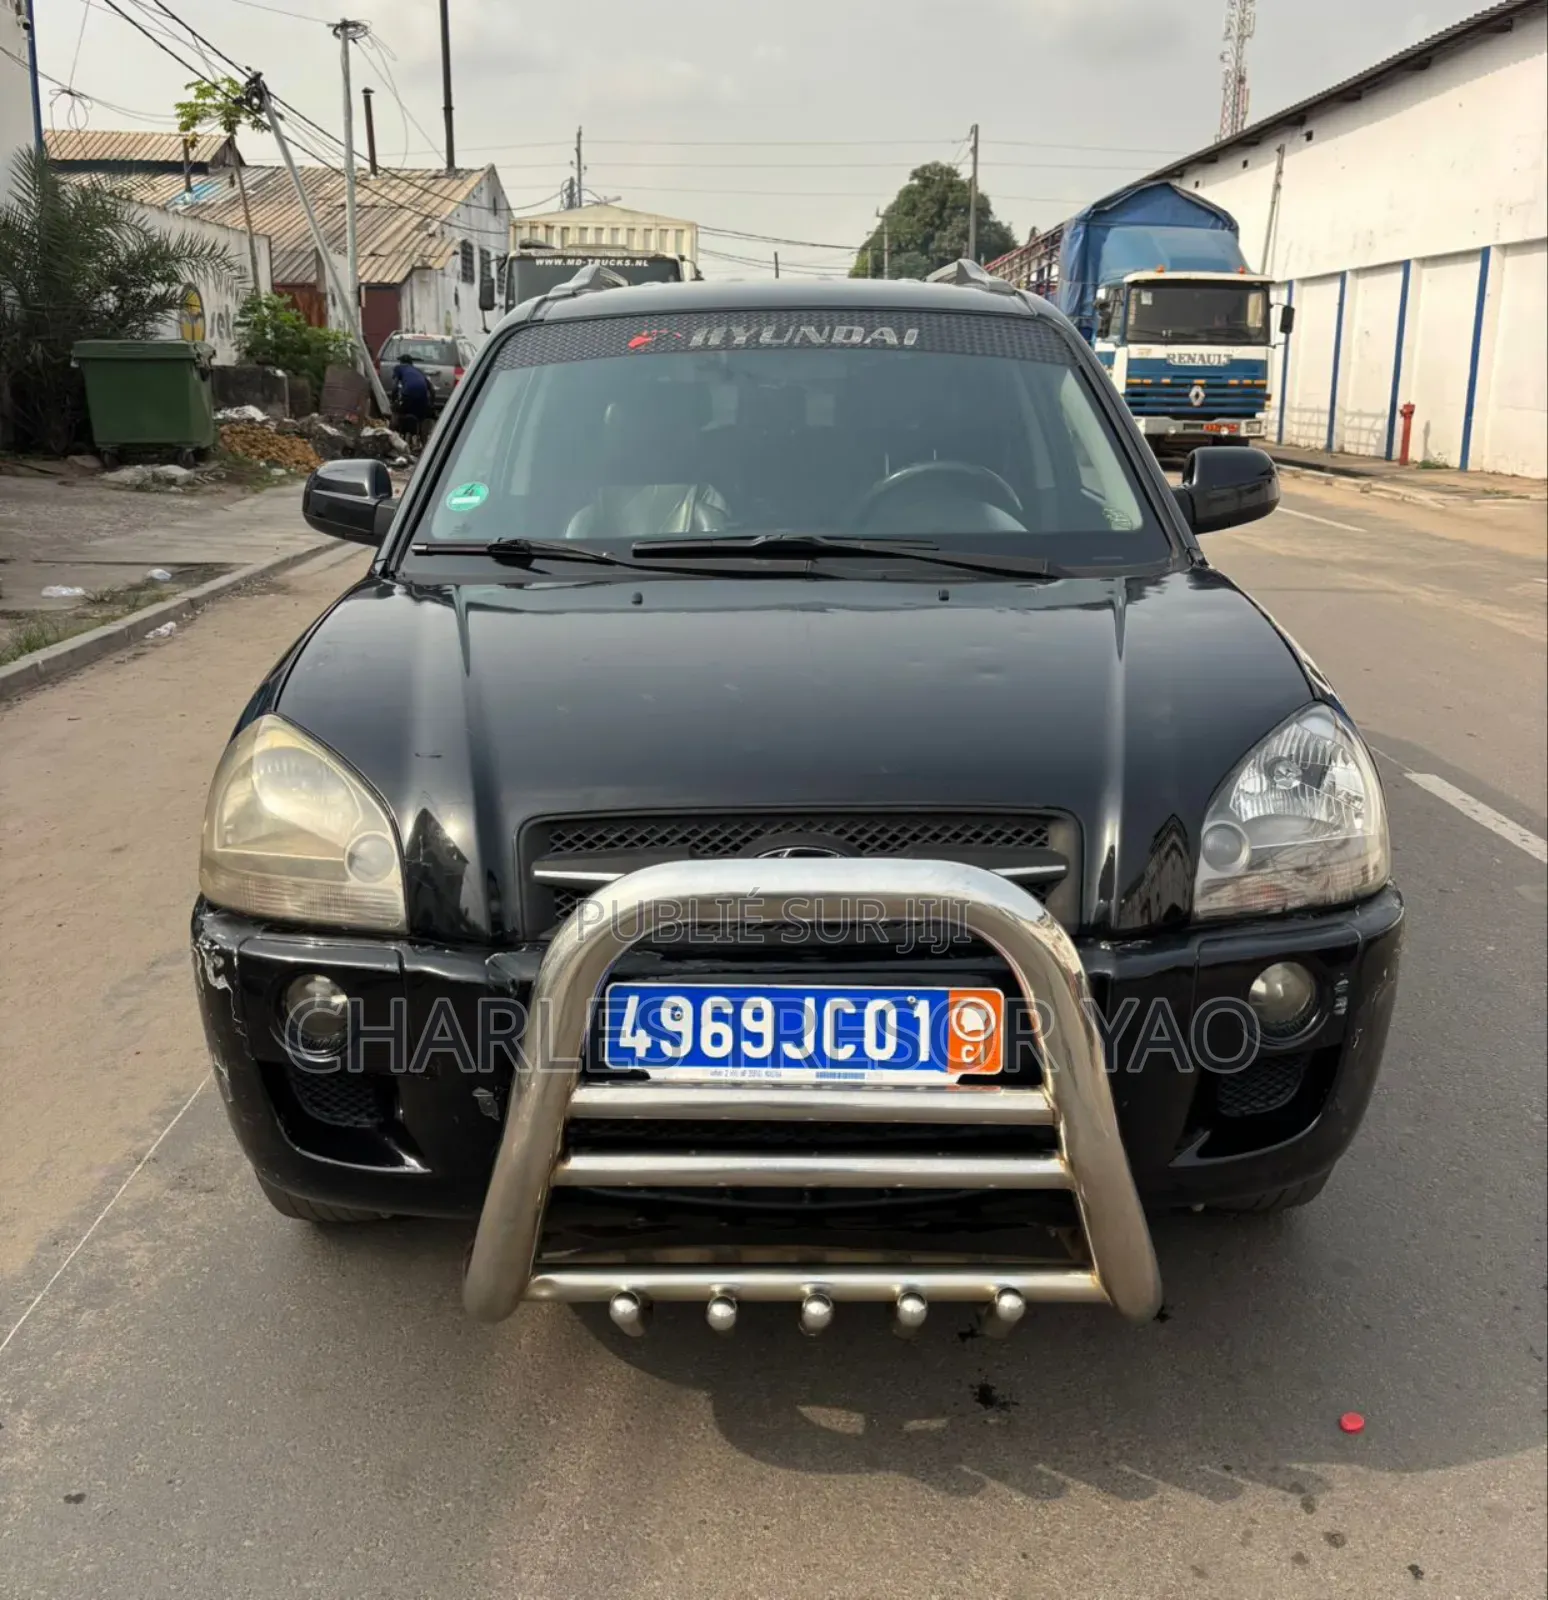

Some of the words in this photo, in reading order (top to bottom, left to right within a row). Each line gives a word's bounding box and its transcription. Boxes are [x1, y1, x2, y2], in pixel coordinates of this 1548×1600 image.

[535, 258, 649, 267] WWW.MD-TRUCKS.NL
[689, 325, 919, 346] HYUNDAI
[1165, 352, 1233, 366] RENAULT
